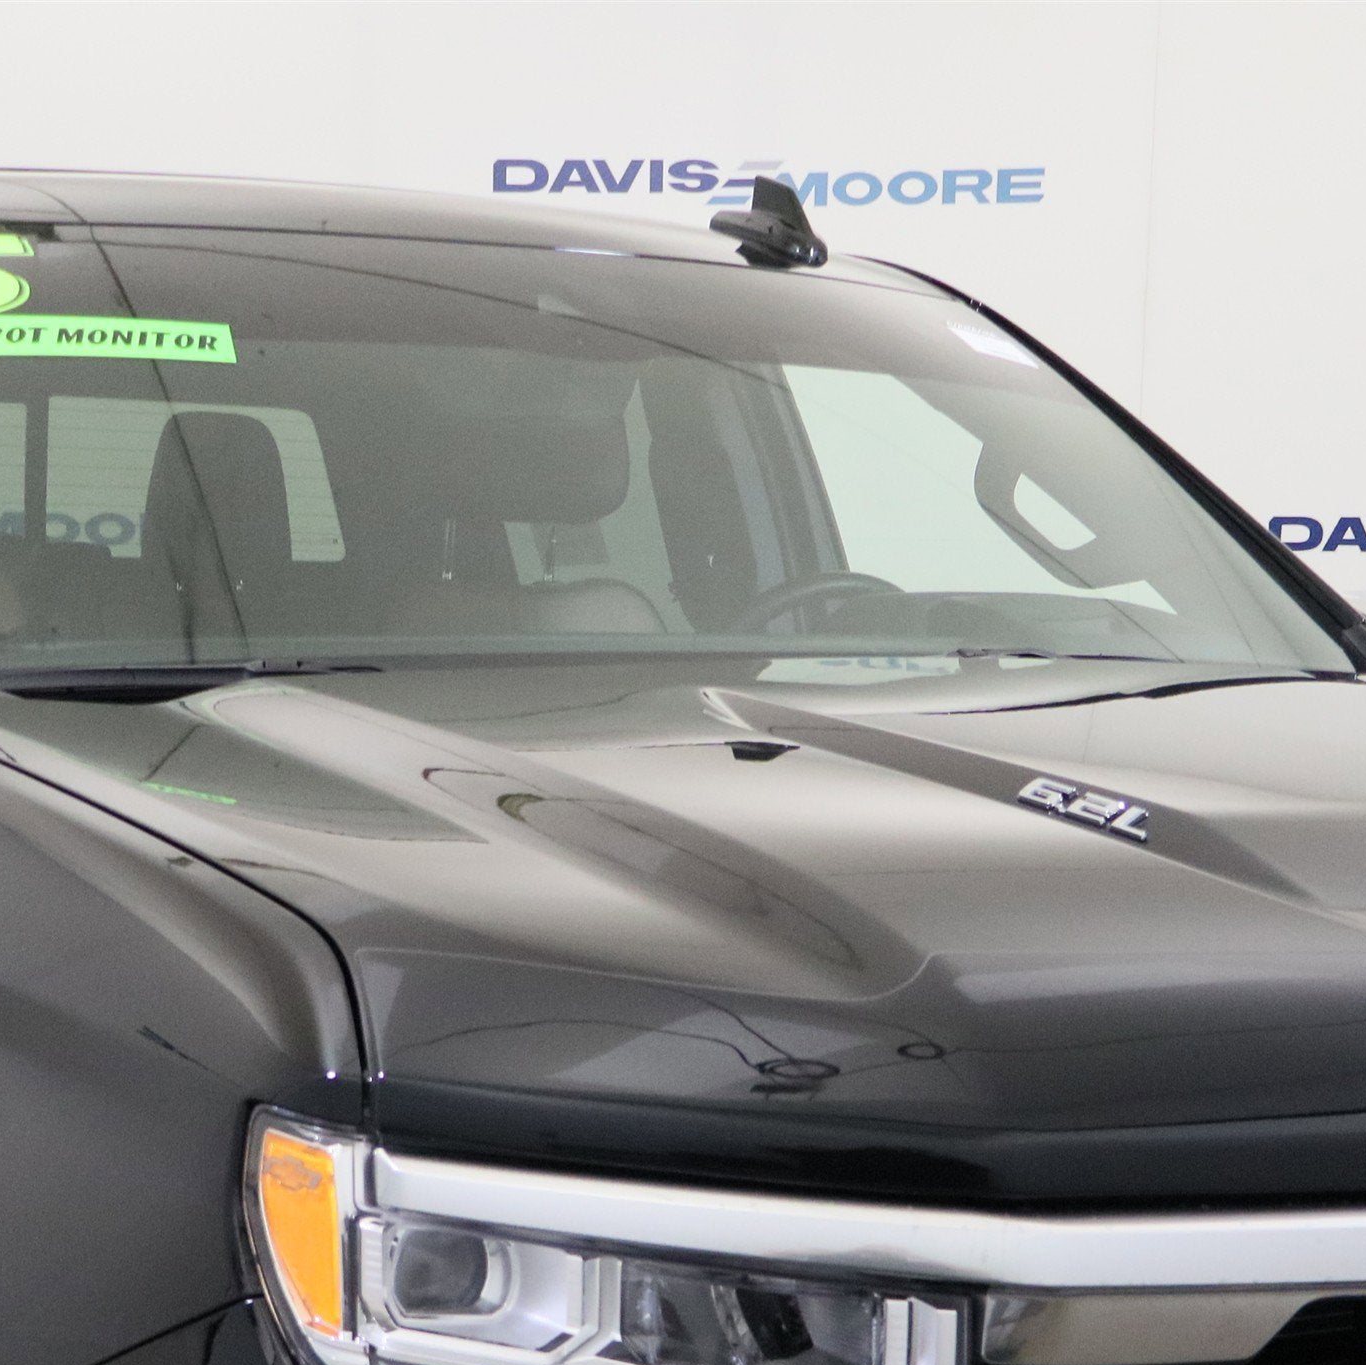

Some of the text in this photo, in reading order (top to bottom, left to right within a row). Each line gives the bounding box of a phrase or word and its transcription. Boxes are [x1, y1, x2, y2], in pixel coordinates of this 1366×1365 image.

[493, 159, 1045, 206] DAVIS MOORE
[56, 327, 218, 351] MONITOR
